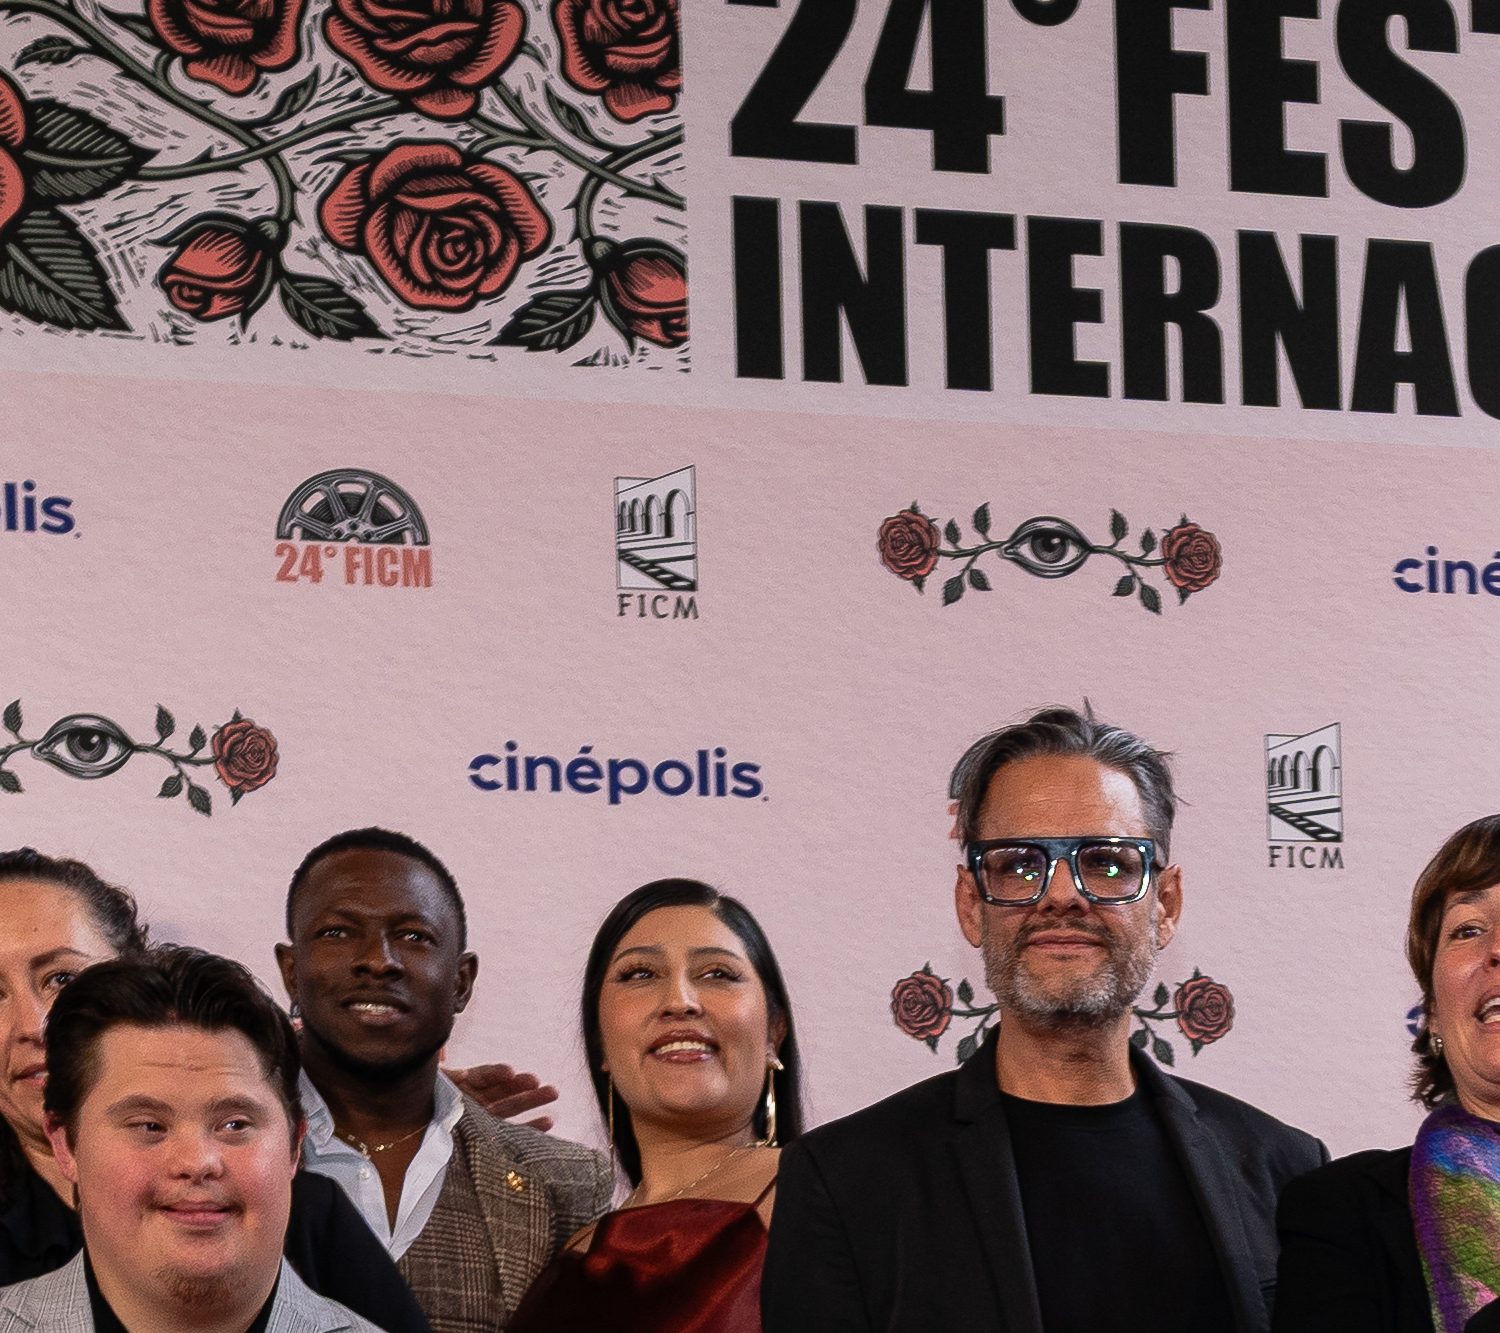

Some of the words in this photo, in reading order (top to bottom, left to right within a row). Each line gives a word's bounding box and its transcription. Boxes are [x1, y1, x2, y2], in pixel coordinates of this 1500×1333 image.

[274, 543, 338, 584] 24°
[344, 545, 433, 588] FICM
[617, 594, 700, 620] FICM
[468, 740, 764, 805] cinépolis
[1268, 845, 1344, 869] FICM
